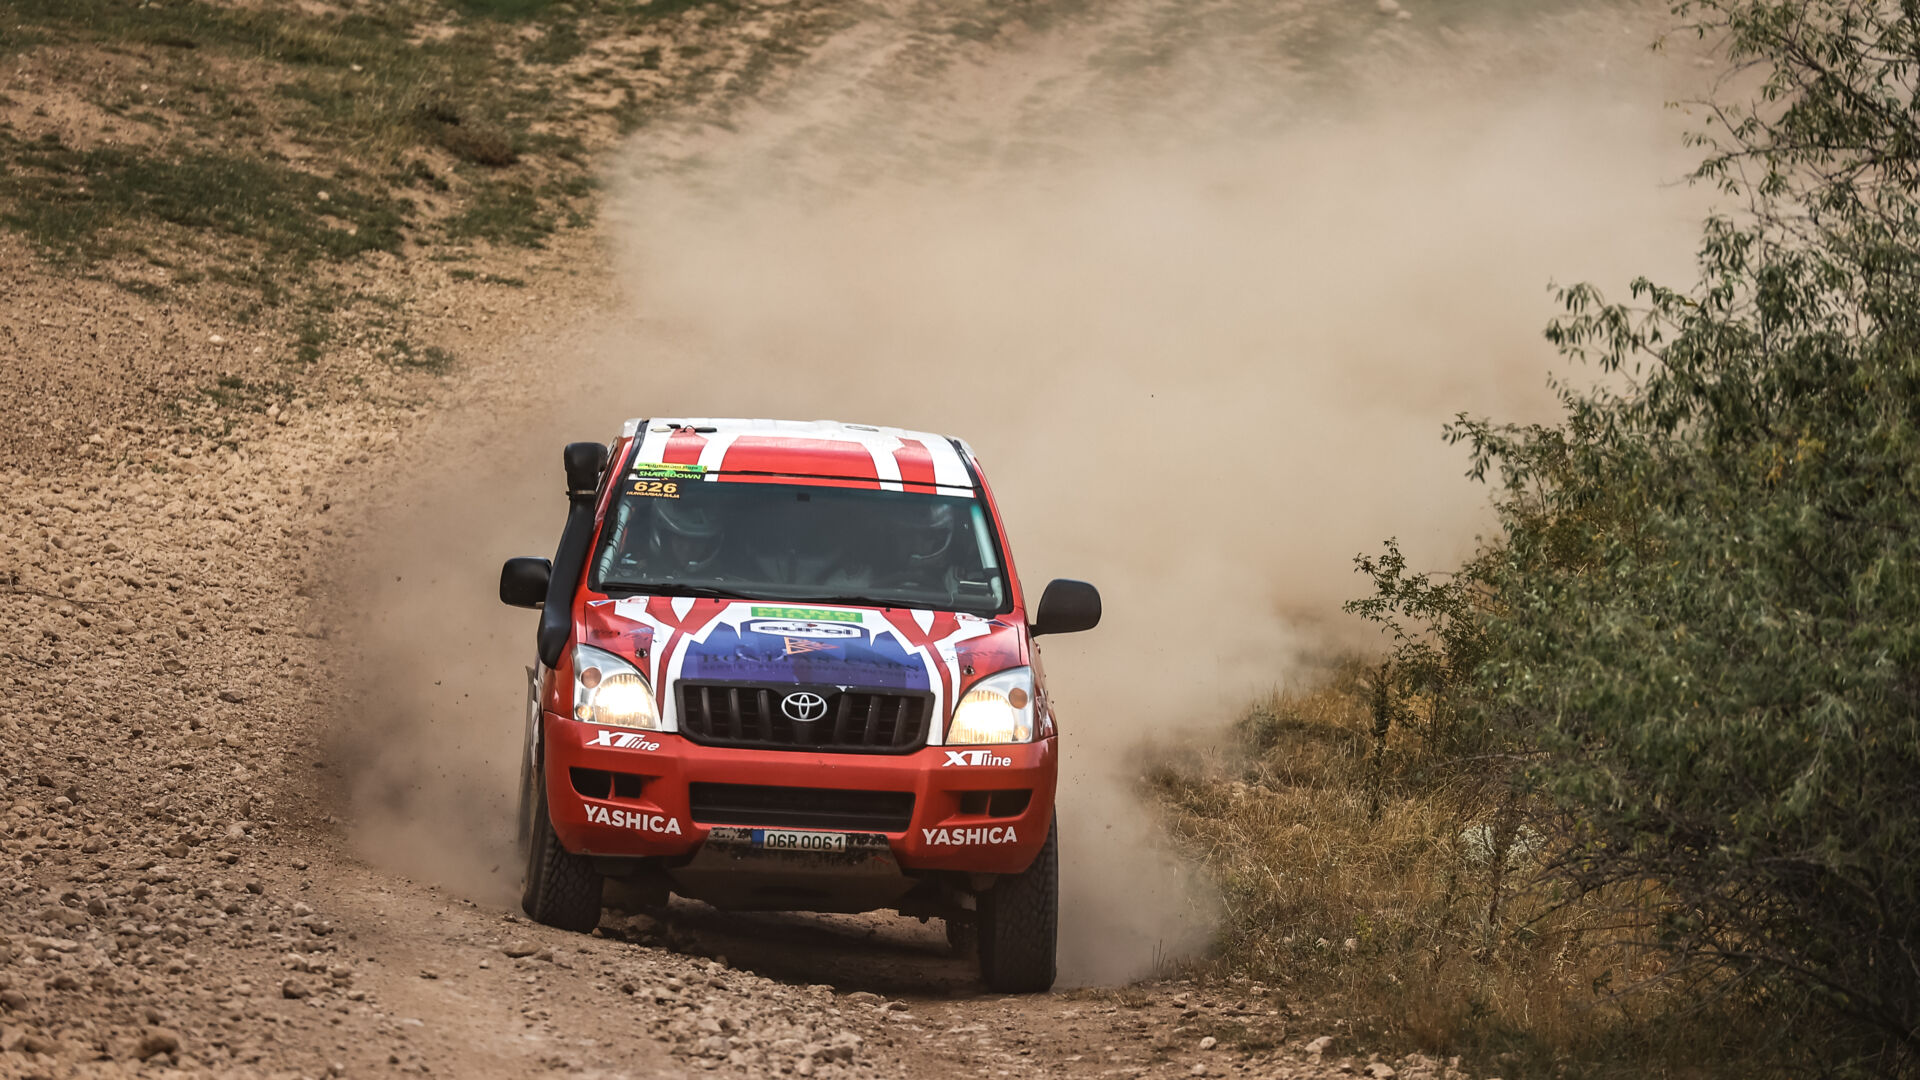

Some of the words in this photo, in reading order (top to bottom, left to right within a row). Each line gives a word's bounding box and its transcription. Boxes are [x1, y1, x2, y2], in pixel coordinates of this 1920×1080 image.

[639, 470, 702, 480] SHAKEDOWN
[634, 481, 678, 494] 626
[584, 804, 682, 835] YASHICA
[766, 833, 798, 849] 06R
[801, 835, 844, 851] 0061
[922, 826, 1018, 845] YASHICA
